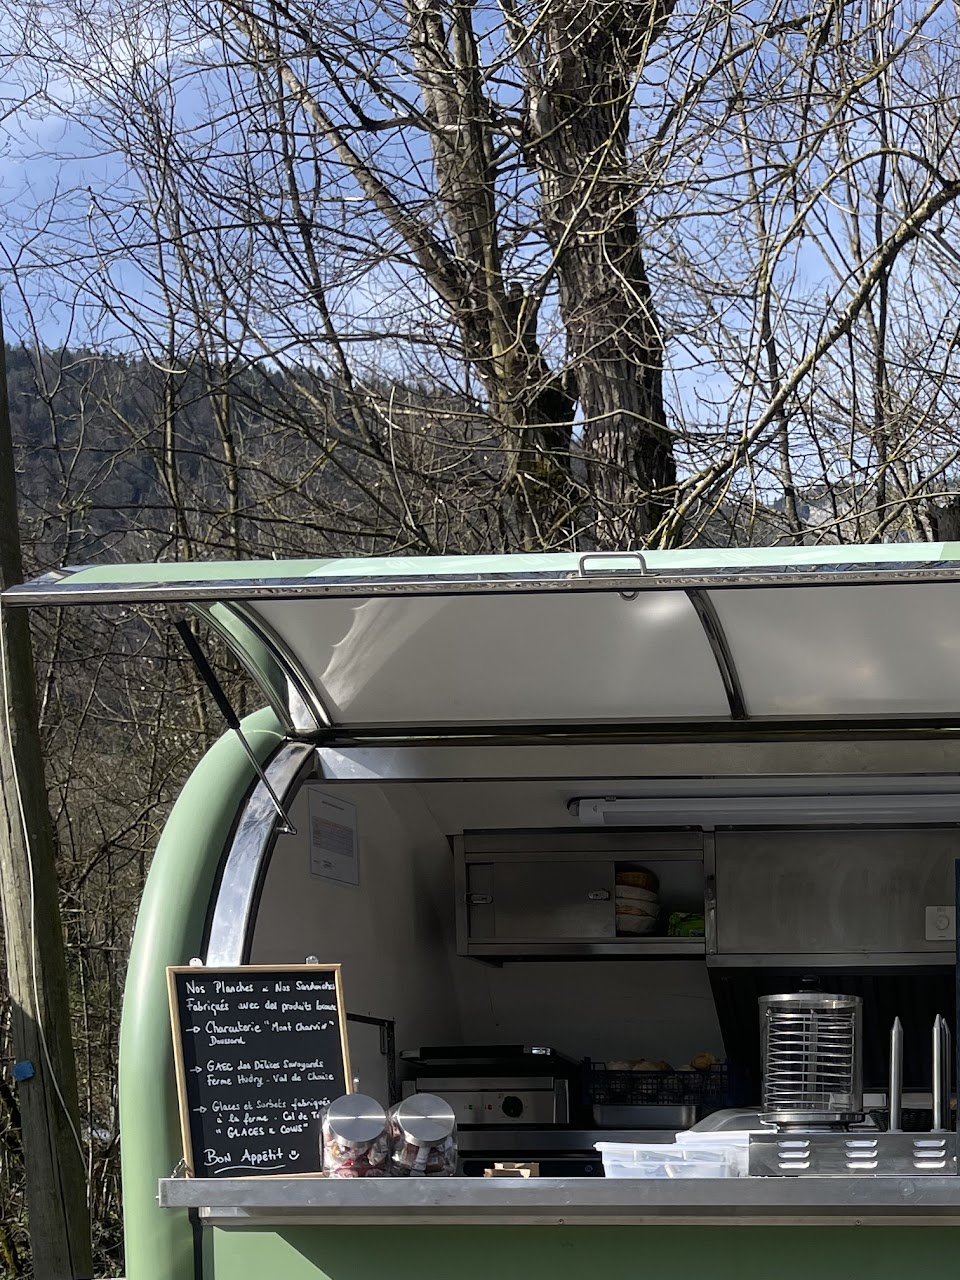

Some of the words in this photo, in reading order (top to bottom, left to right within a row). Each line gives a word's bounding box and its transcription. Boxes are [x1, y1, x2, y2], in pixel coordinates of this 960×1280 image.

[186, 980, 206, 994] Nos
[213, 980, 254, 993] Planches
[275, 981, 290, 992] Nos
[186, 998, 229, 1016] Fabriqués
[265, 1000, 277, 1010] des
[282, 1001, 311, 1013] produits
[205, 1020, 262, 1034] Charcuterie
[206, 1060, 234, 1072] GAEC
[283, 1059, 324, 1071] Savoyards
[206, 1074, 232, 1086] Ferme
[273, 1074, 287, 1082] Val
[291, 1073, 301, 1082] de
[212, 1100, 240, 1112] Glaces
[243, 1101, 253, 1110] et
[256, 1099, 286, 1108] Sorbets
[217, 1113, 222, 1123] à
[228, 1113, 240, 1123] la
[243, 1112, 269, 1125] ferme
[283, 1111, 295, 1121] Col
[298, 1111, 308, 1120] de
[241, 1148, 283, 1165] Appétit
